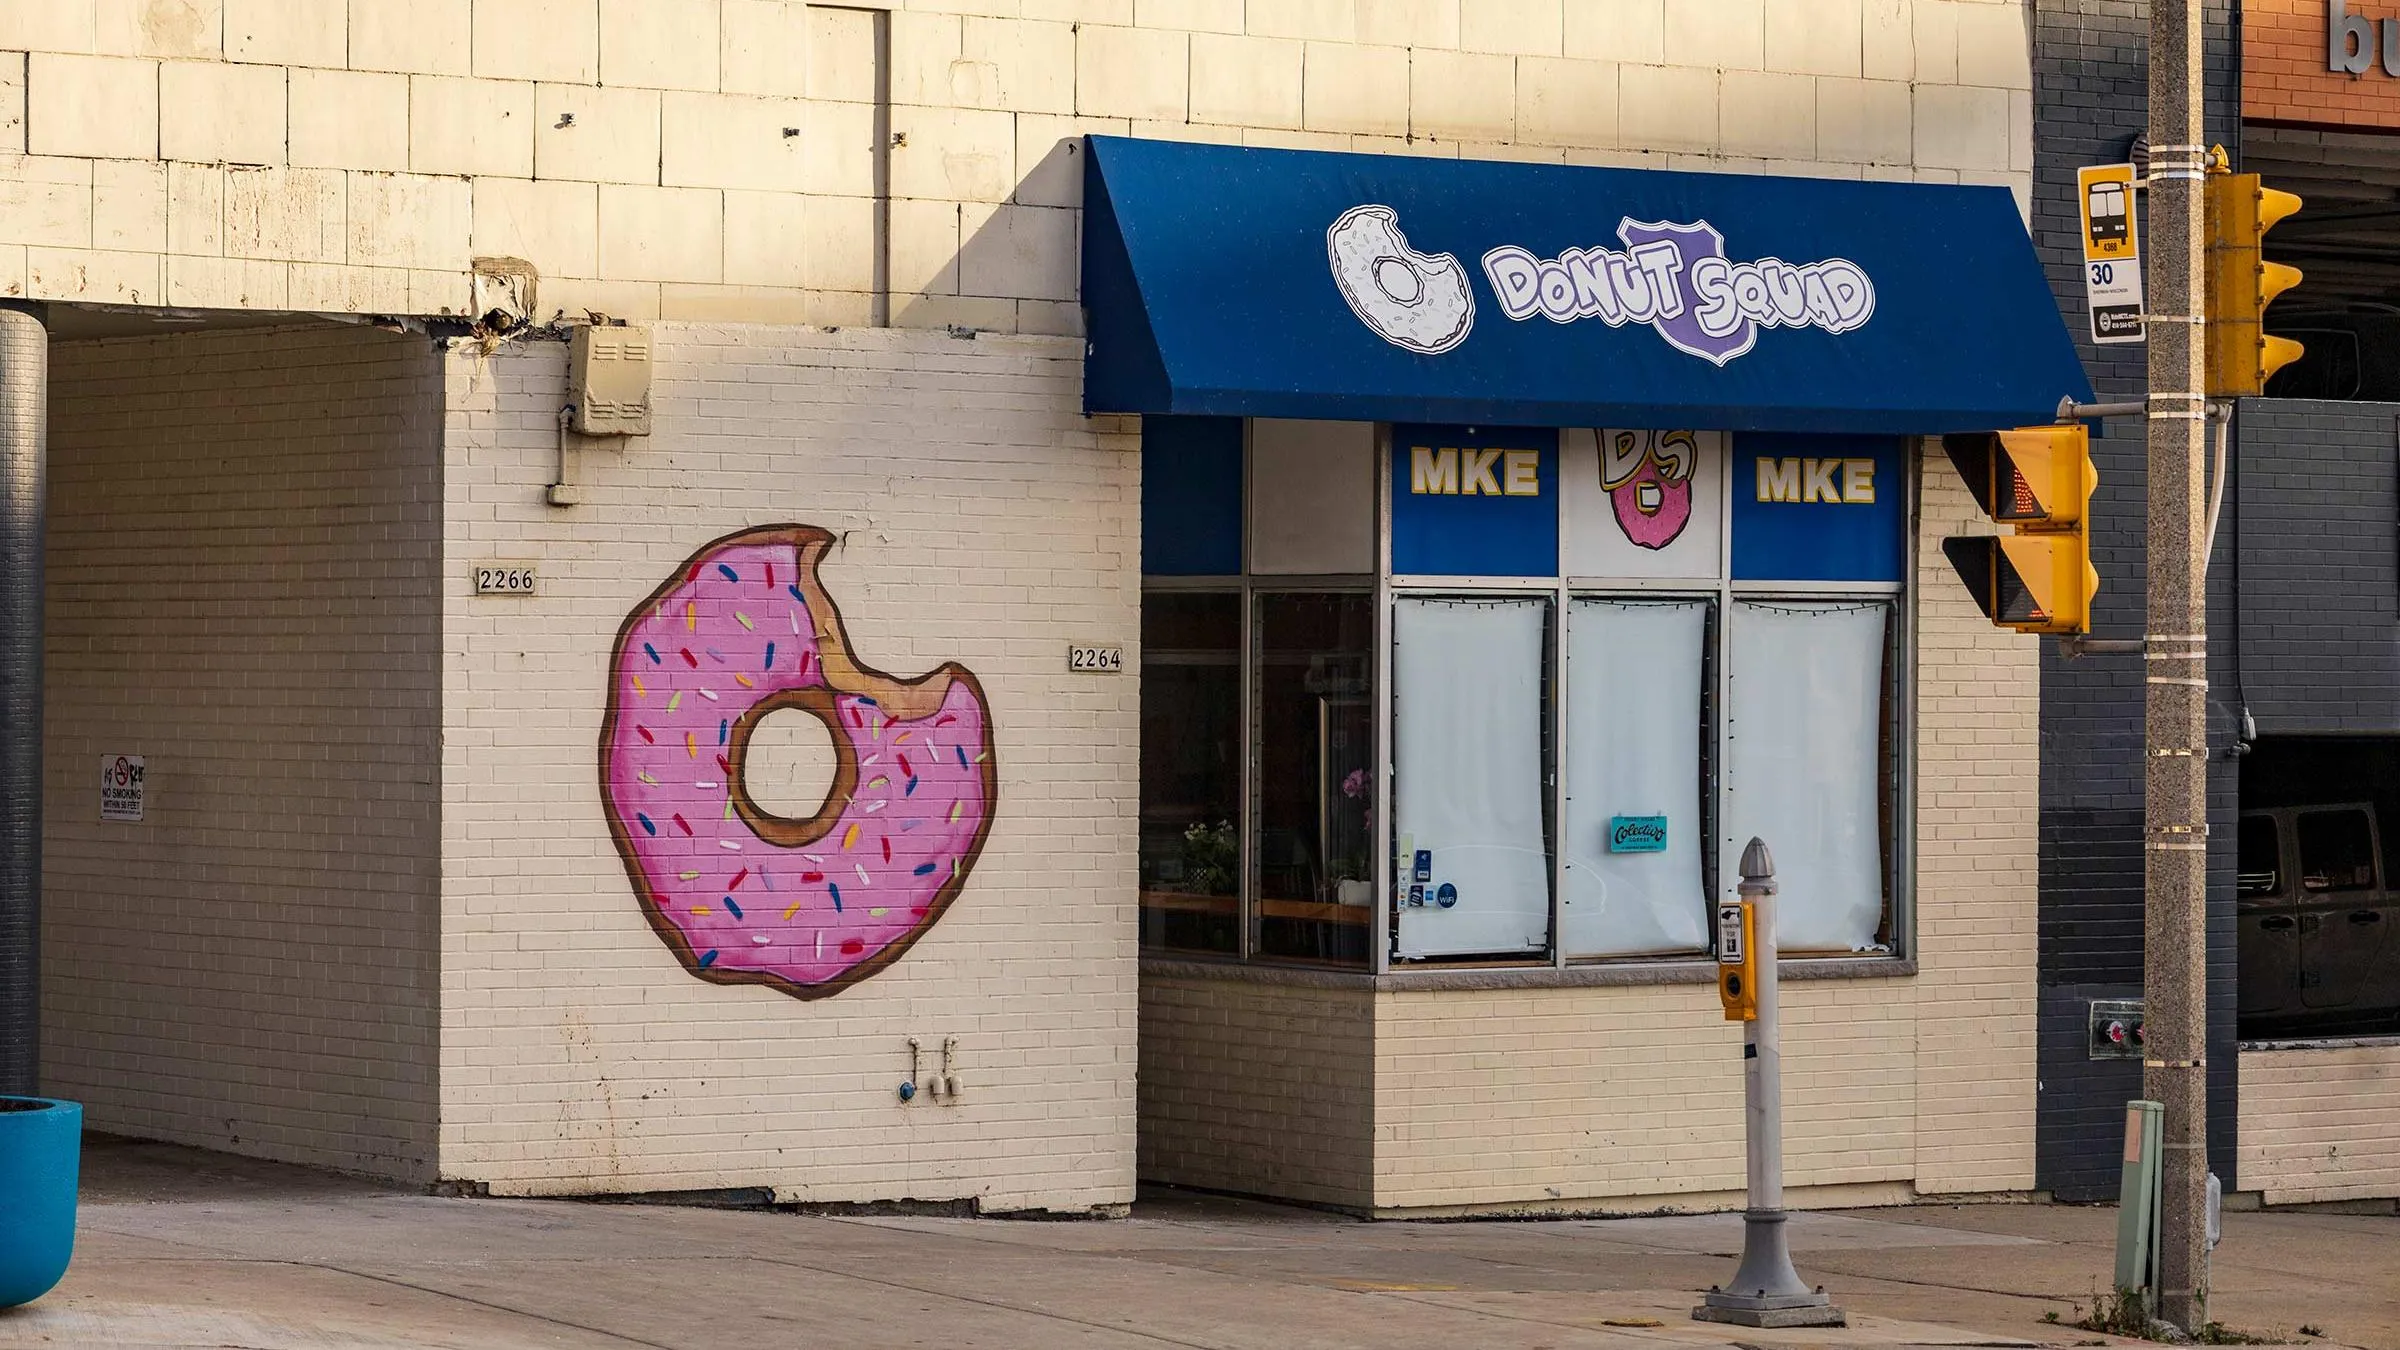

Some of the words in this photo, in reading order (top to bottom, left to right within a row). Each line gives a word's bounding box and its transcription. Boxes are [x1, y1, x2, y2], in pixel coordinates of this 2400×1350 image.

[2091, 263, 2113, 286] 30
[1693, 259, 1872, 335] SQUAD
[1411, 447, 1539, 496] MKE
[1756, 457, 1875, 503] MKE
[480, 570, 533, 589] 2266
[1074, 649, 1121, 668] 2264
[102, 787, 111, 798] NO
[112, 788, 142, 800] SMOKING
[1615, 823, 1665, 844] Colectivo
